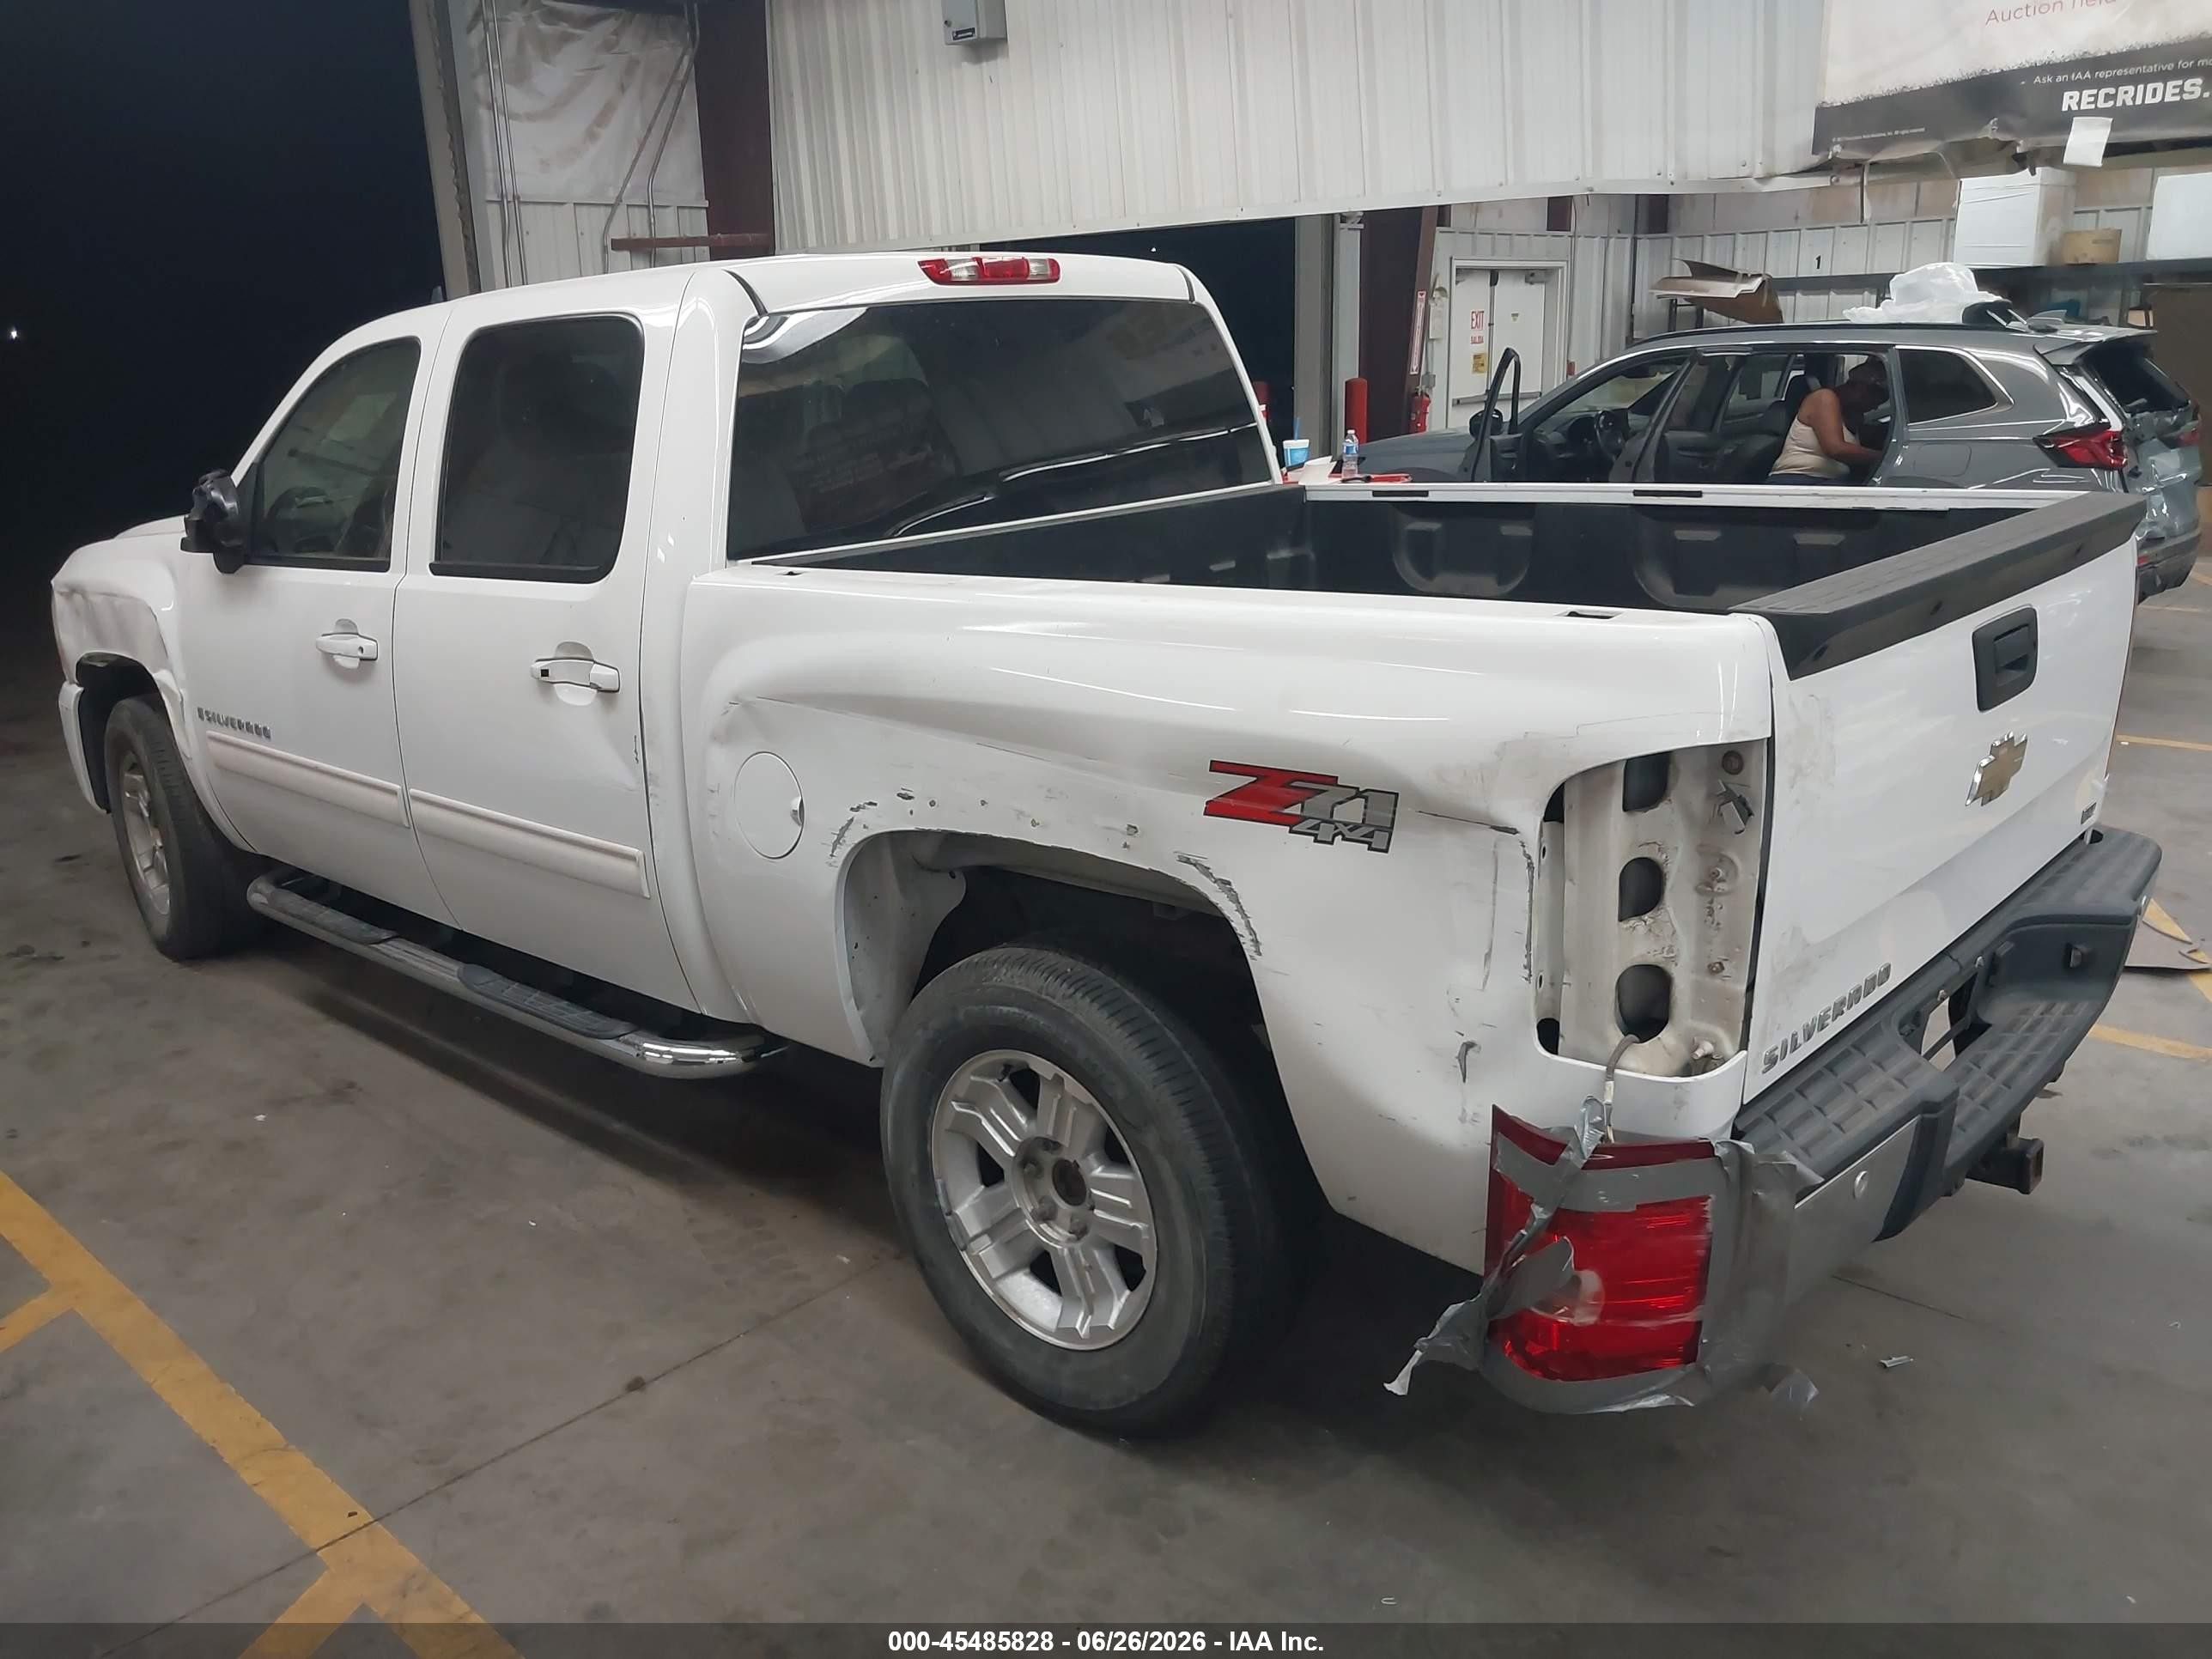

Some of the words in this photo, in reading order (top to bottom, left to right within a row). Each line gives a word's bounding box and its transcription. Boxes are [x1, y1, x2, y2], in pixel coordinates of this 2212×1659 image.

[1985, 1, 2063, 26] Auction
[2033, 75, 2053, 84] Ask
[2071, 70, 2091, 81] IAA
[2094, 63, 2174, 78] representative
[2178, 60, 2195, 70] for
[2062, 78, 2210, 112] RECRIDES.
[1815, 255, 1821, 270] 1
[1471, 311, 1484, 330] EXIT
[1203, 759, 1399, 830] Z71
[1762, 963, 1892, 1074] SILVERADO
